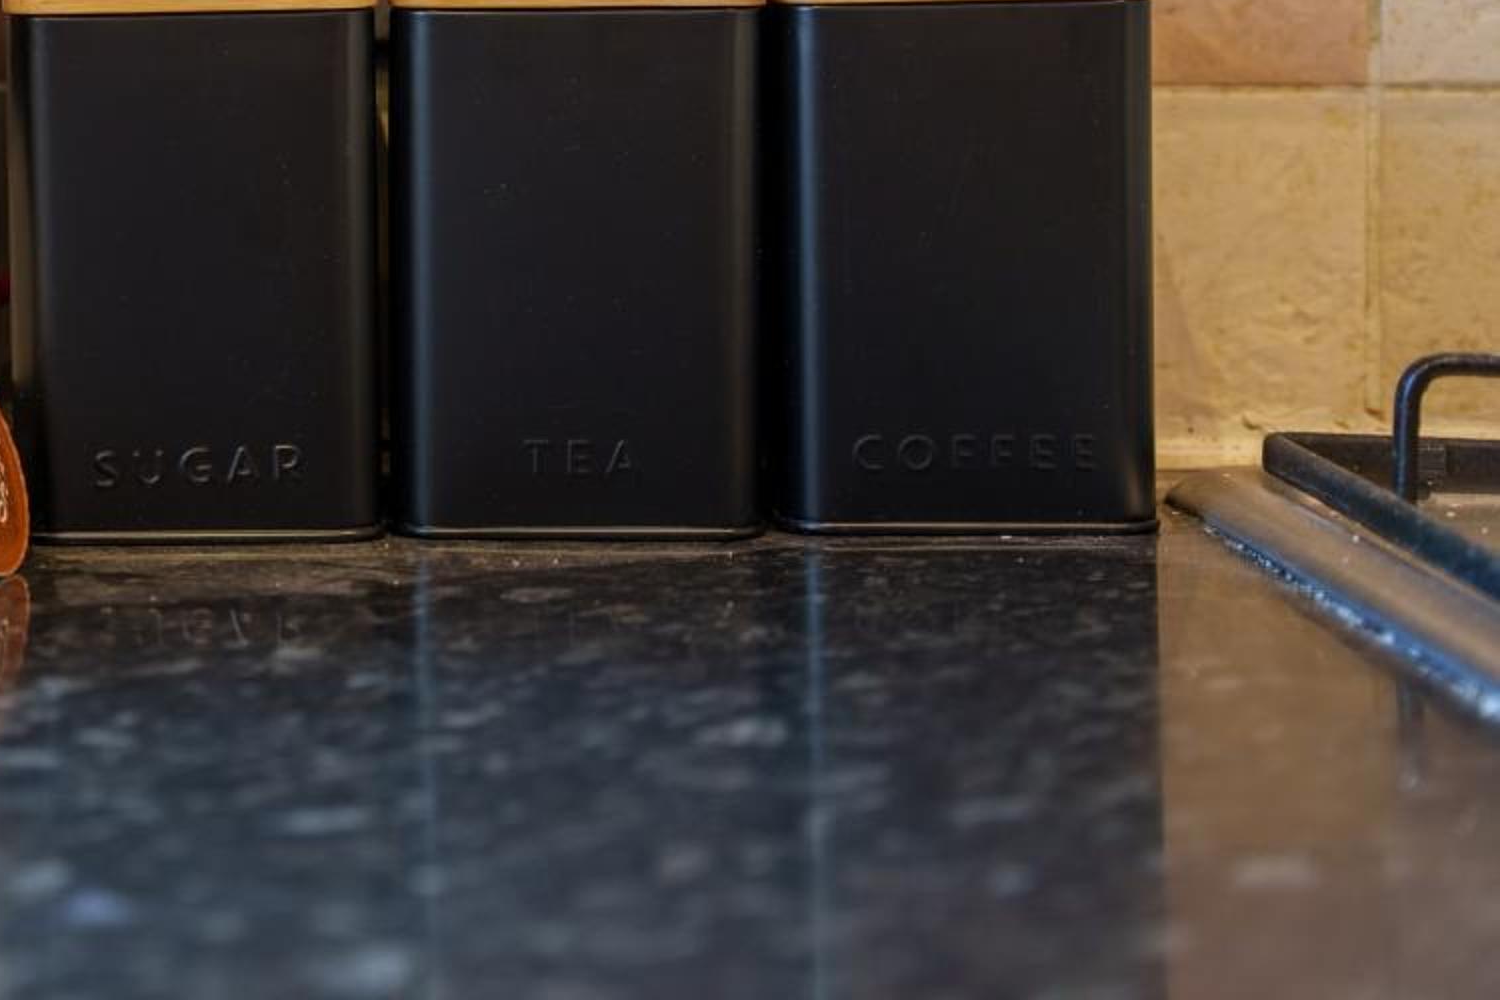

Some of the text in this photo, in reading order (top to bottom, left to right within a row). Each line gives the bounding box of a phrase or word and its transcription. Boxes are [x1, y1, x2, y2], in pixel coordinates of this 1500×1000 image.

[93, 443, 303, 488] SUGAR
[522, 438, 635, 475] TEA
[850, 433, 1098, 472] COFFEE
